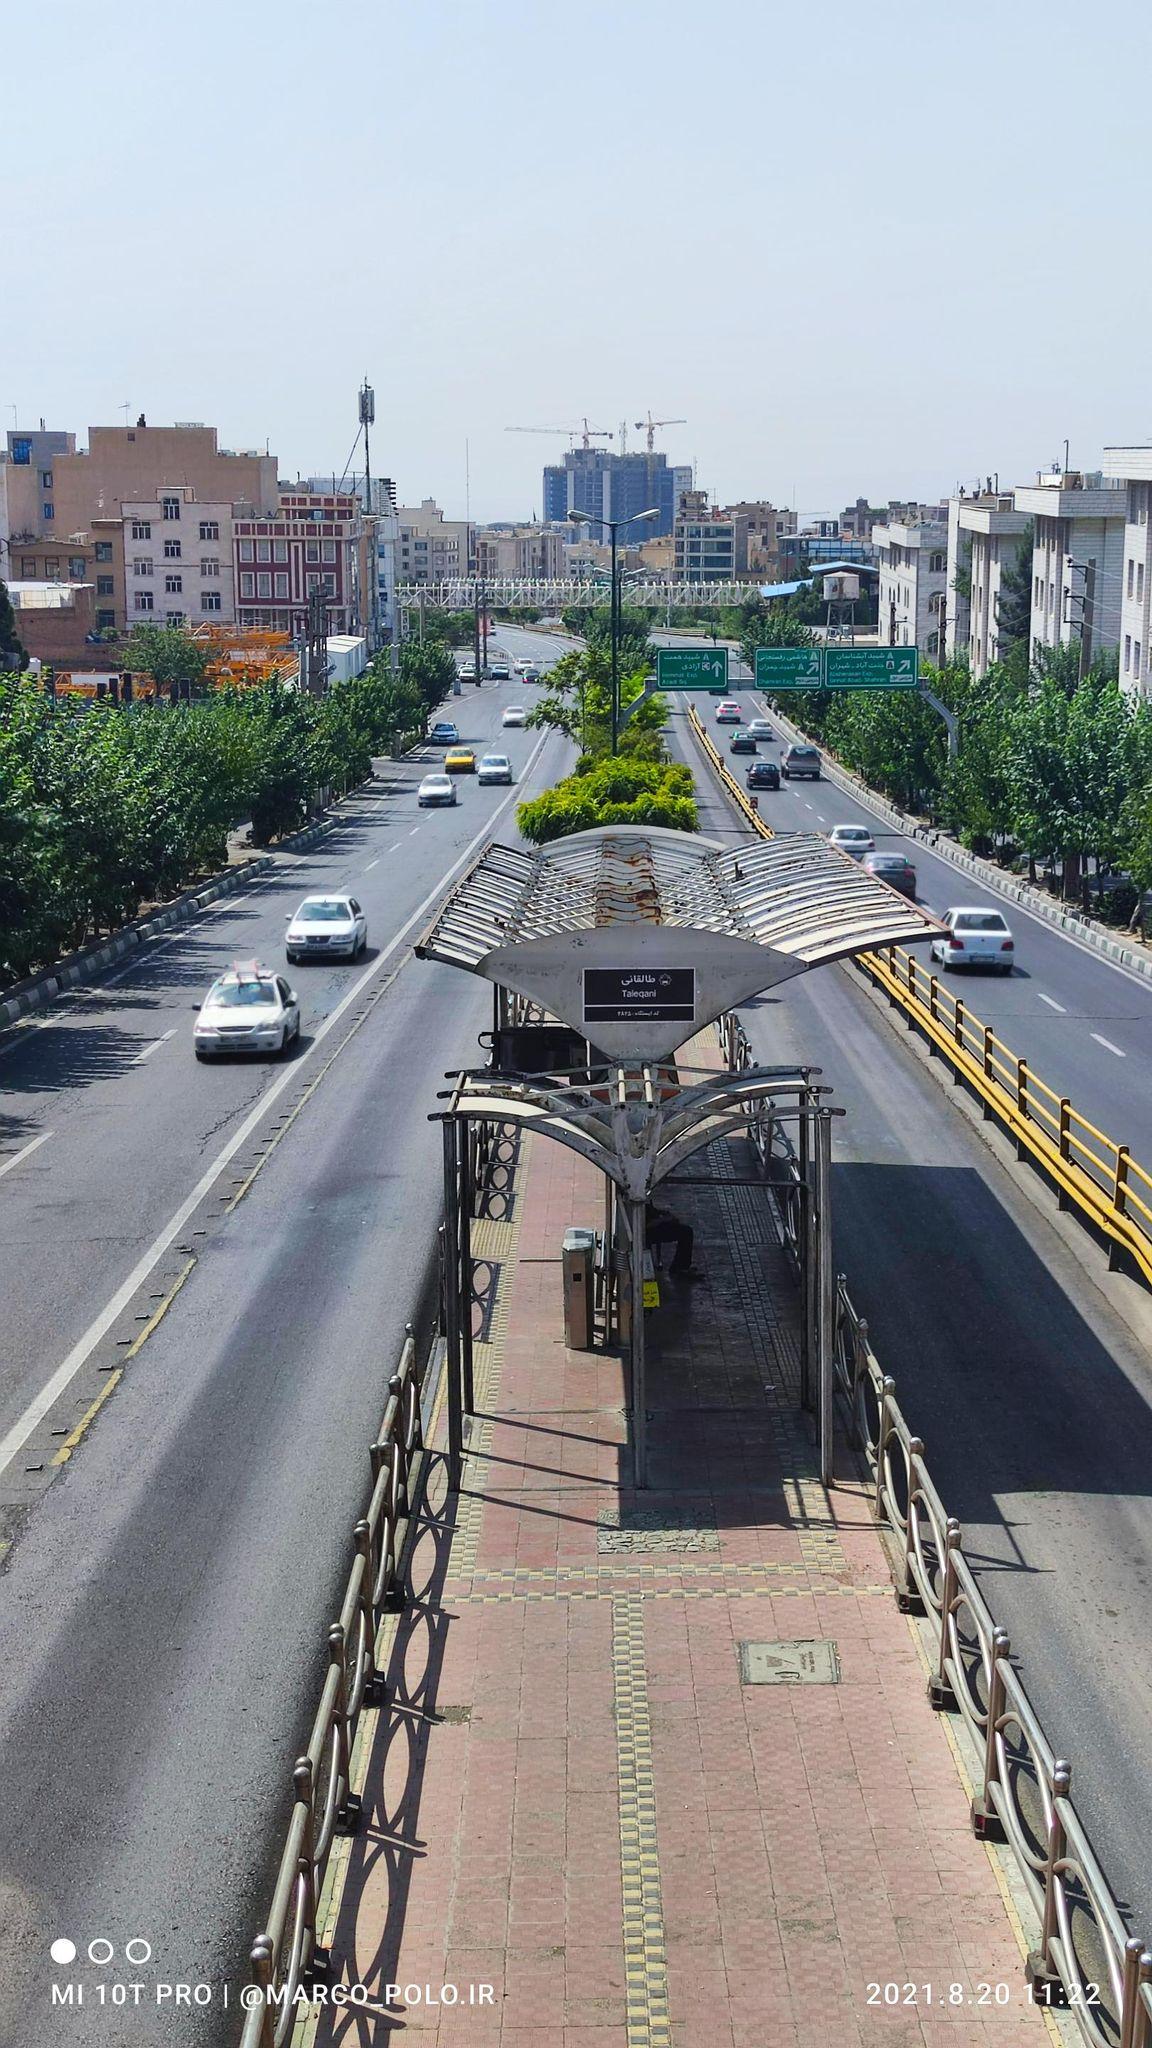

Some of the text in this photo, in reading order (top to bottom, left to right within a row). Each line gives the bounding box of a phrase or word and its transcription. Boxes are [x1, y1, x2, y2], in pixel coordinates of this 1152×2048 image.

[681, 662, 700, 671] آزادی
[621, 974, 656, 986] طالقانی
[622, 990, 656, 999] Taleqani
